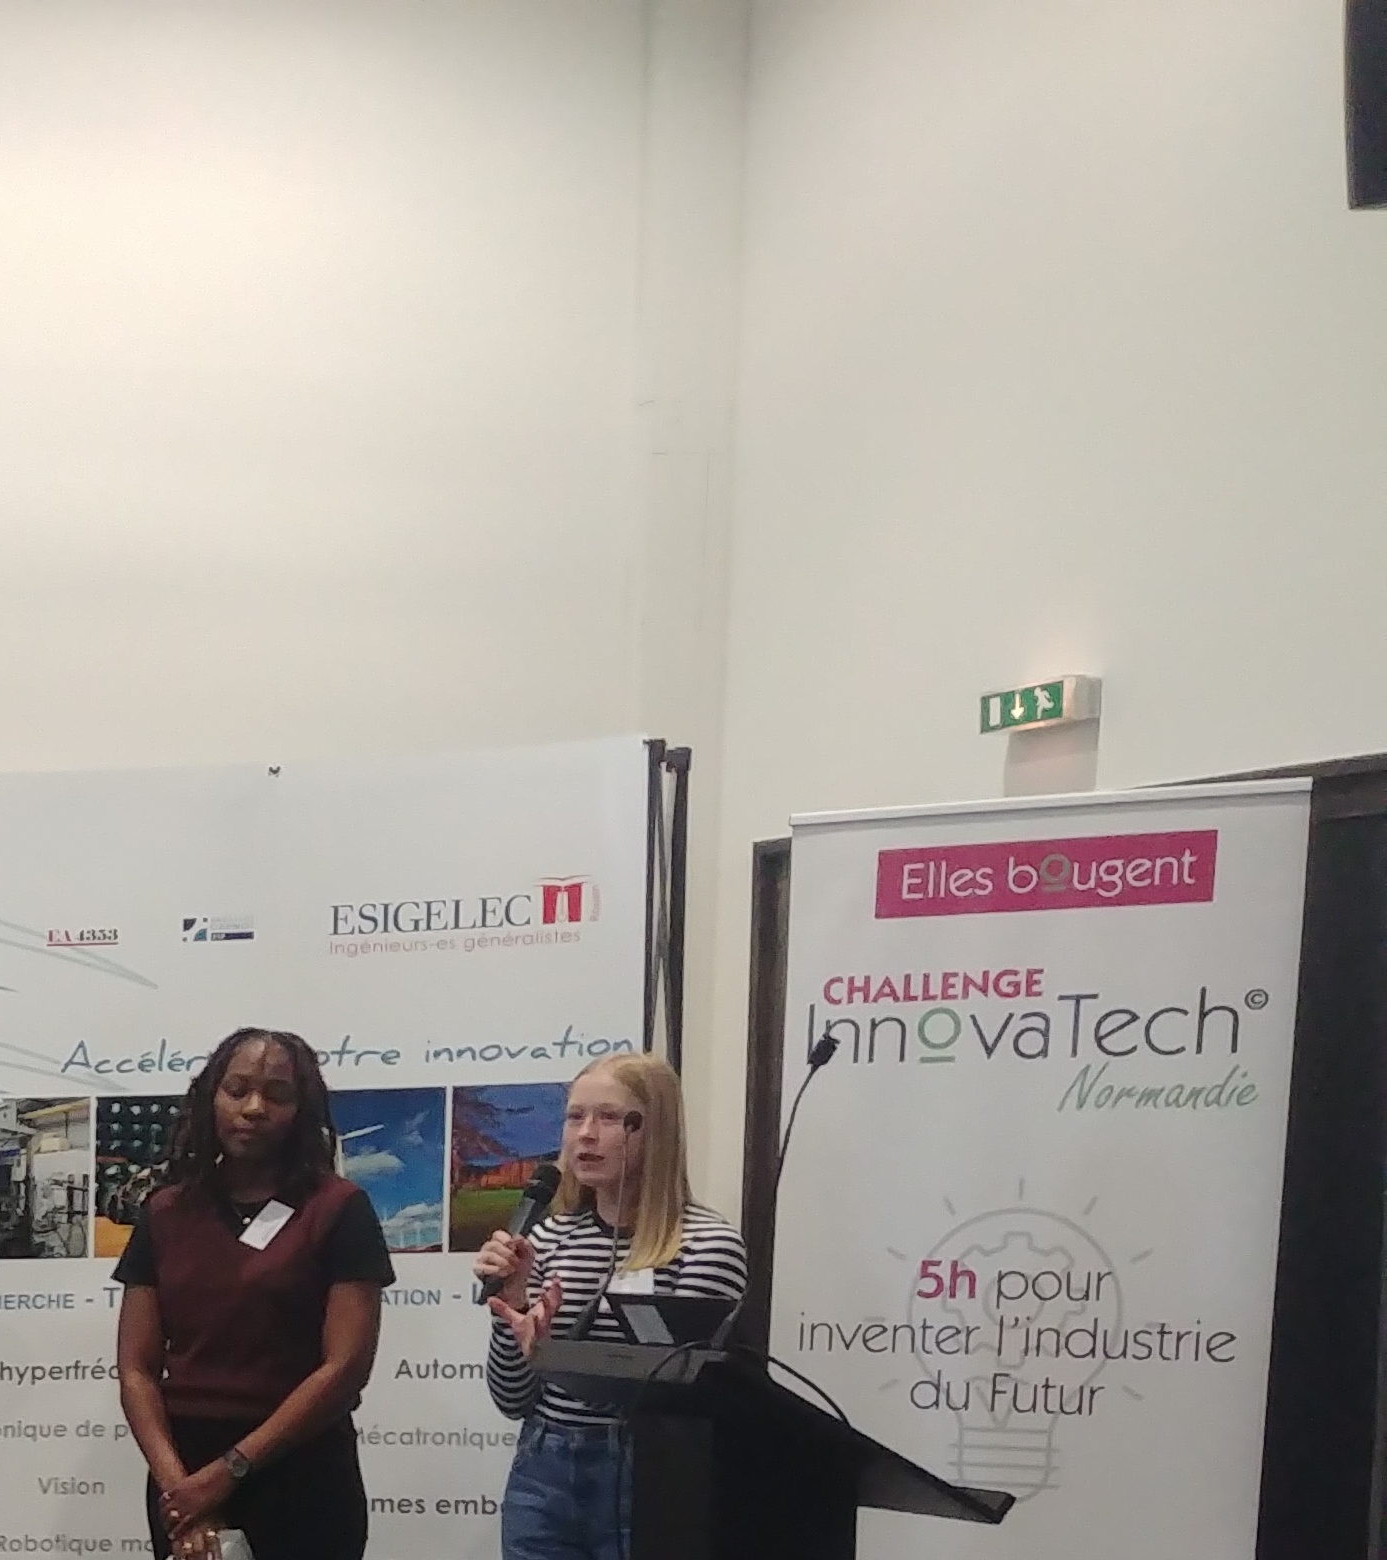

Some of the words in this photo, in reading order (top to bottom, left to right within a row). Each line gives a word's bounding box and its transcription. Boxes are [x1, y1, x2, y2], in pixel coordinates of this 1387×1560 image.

[901, 858, 994, 900] Elles
[1007, 847, 1198, 899] bougent
[329, 894, 532, 936] ESIGELEC
[329, 937, 457, 958] Ingénieurs-es
[464, 929, 582, 952] généralistes
[823, 967, 1045, 1006] CHALLENGE
[315, 1034, 401, 1067] otre
[425, 1024, 634, 1064] innovation
[1057, 1062, 1259, 1112] Normandie
[916, 1259, 977, 1300] 5h
[996, 1267, 1113, 1309] pour
[798, 1310, 981, 1354] inventer
[998, 1314, 1236, 1364] l'industrie
[394, 1358, 484, 1380] Autom
[910, 1369, 971, 1412] du
[990, 1372, 1105, 1416] Futur
[76, 1420, 105, 1438] de
[360, 1425, 517, 1451] écatronique
[38, 1477, 105, 1496] Vision
[370, 1497, 426, 1514] mes
[435, 1494, 498, 1515] emb
